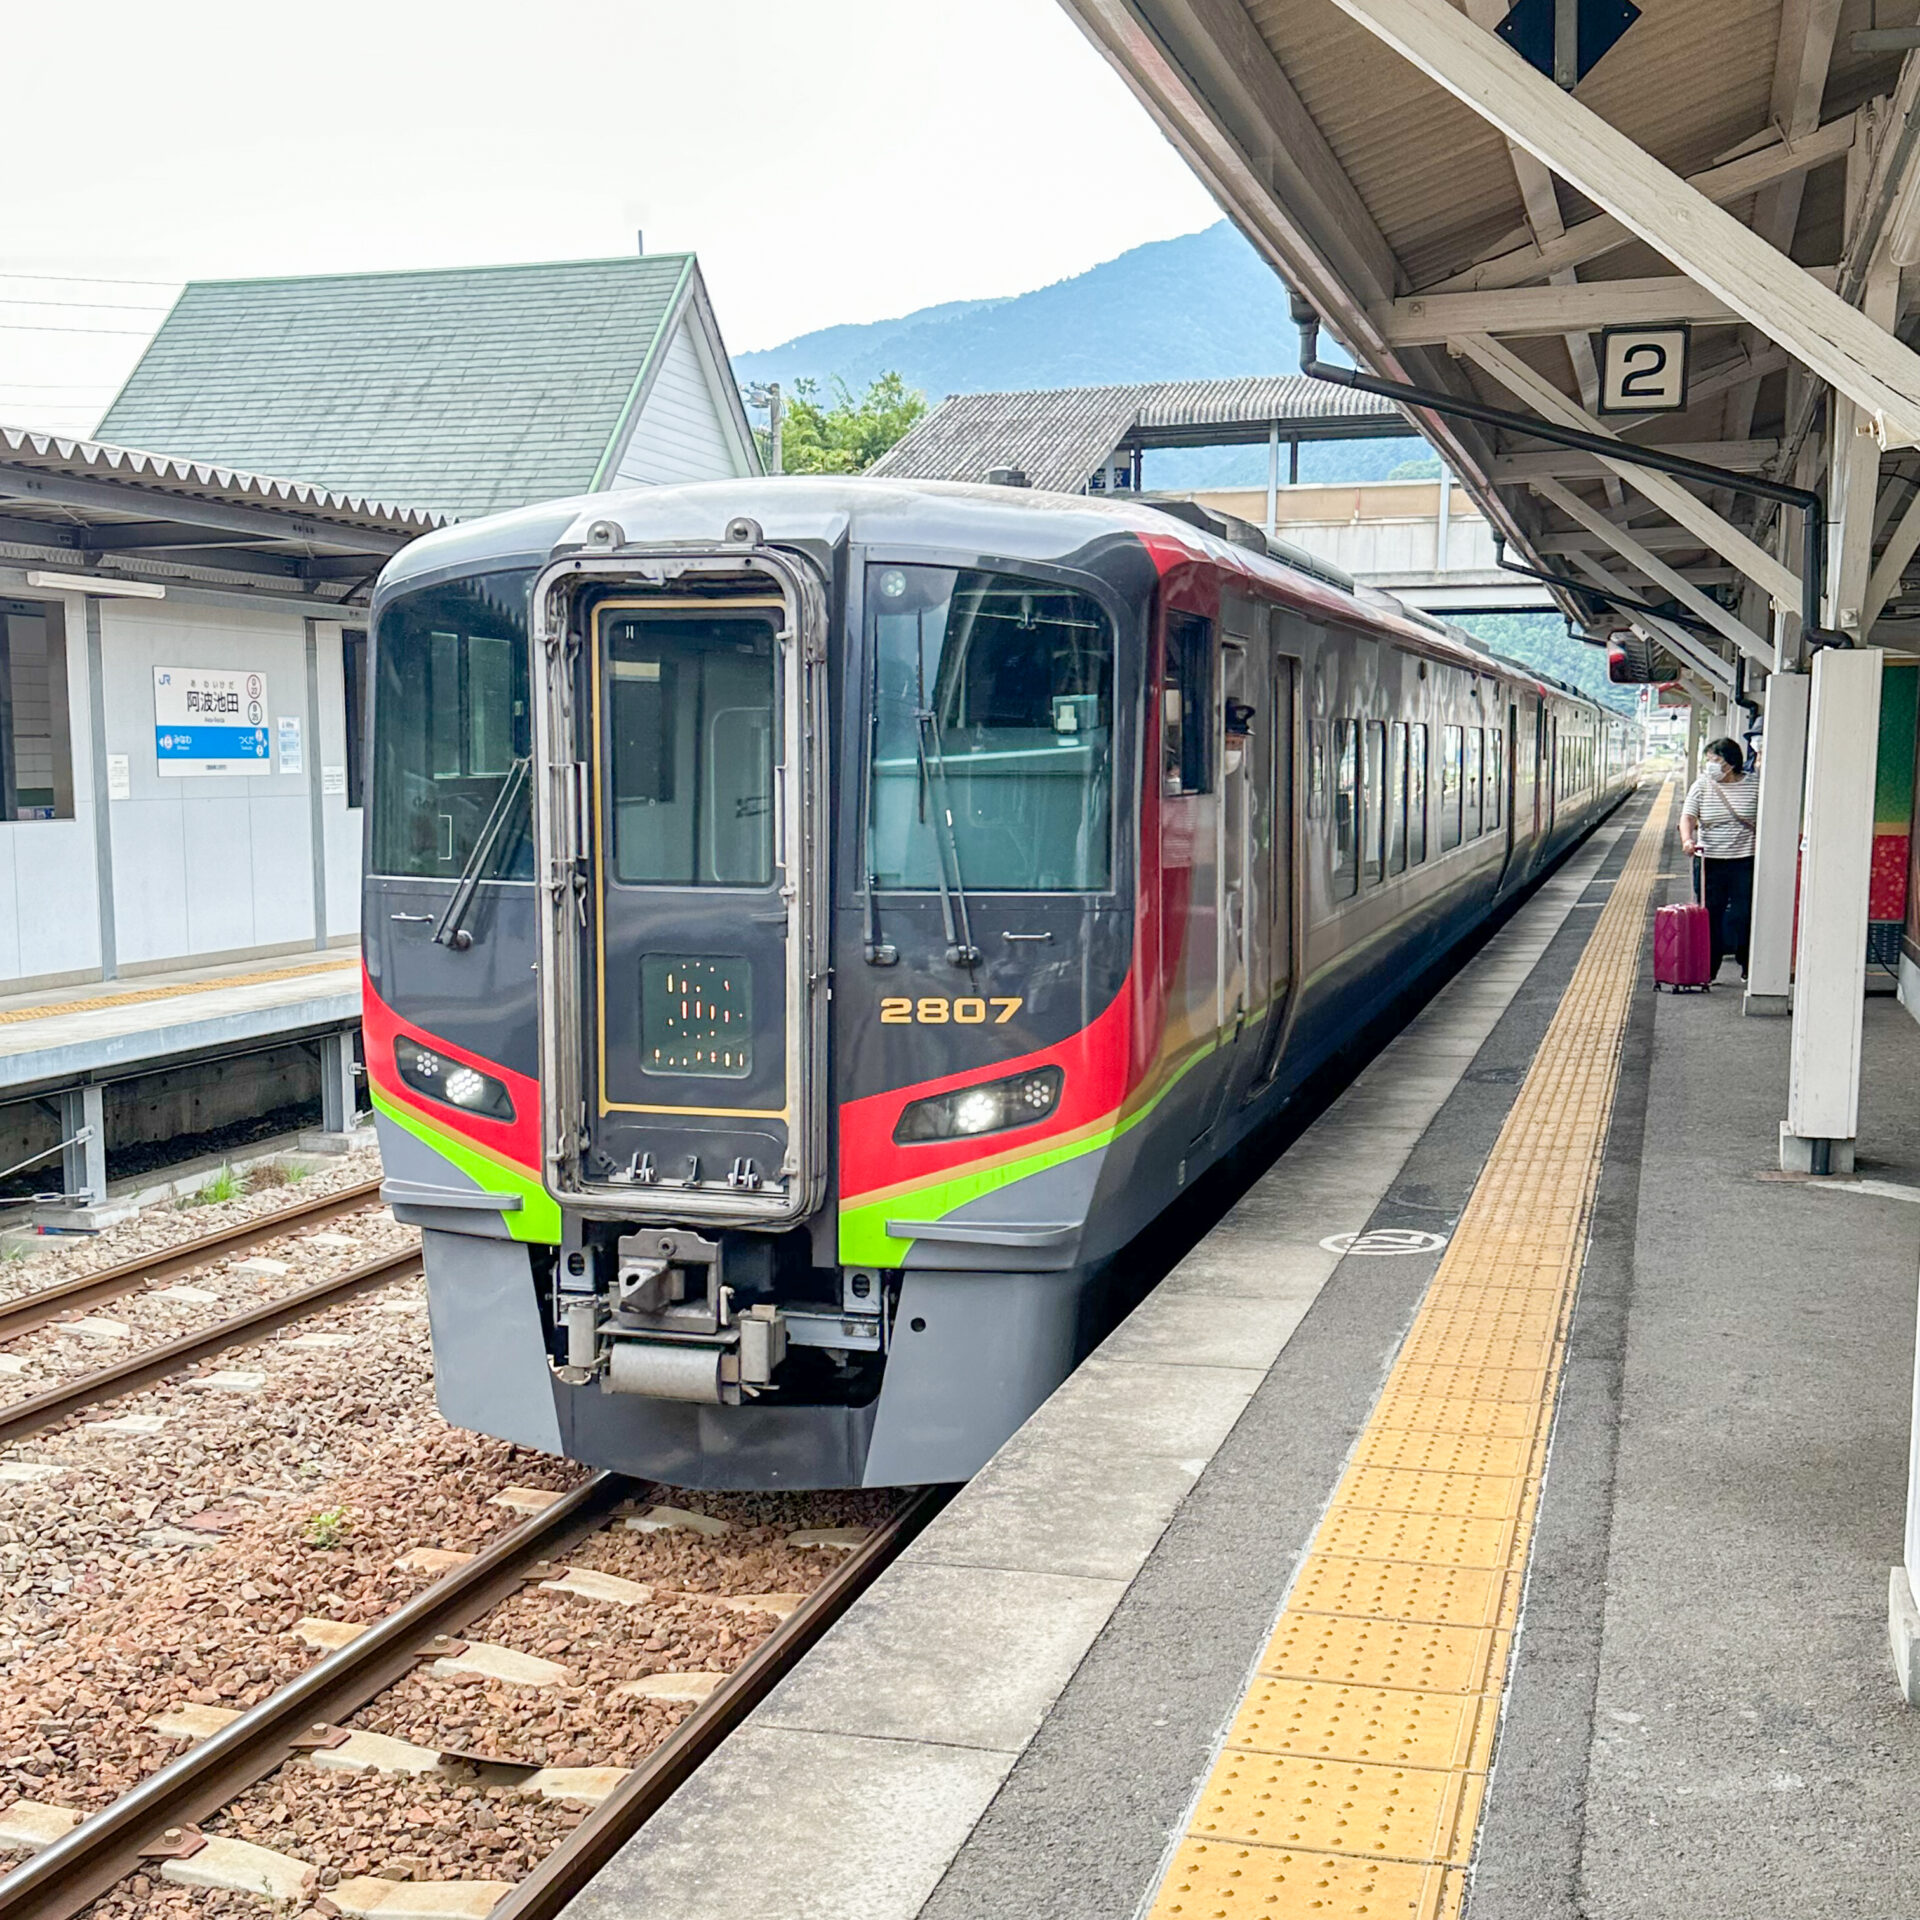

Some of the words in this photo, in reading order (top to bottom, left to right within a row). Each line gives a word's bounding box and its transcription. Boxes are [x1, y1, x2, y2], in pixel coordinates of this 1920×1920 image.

[1621, 344, 1667, 397] 2
[158, 674, 171, 685] JR
[186, 691, 239, 713] 阿波池田
[880, 997, 1023, 1024] 2807
